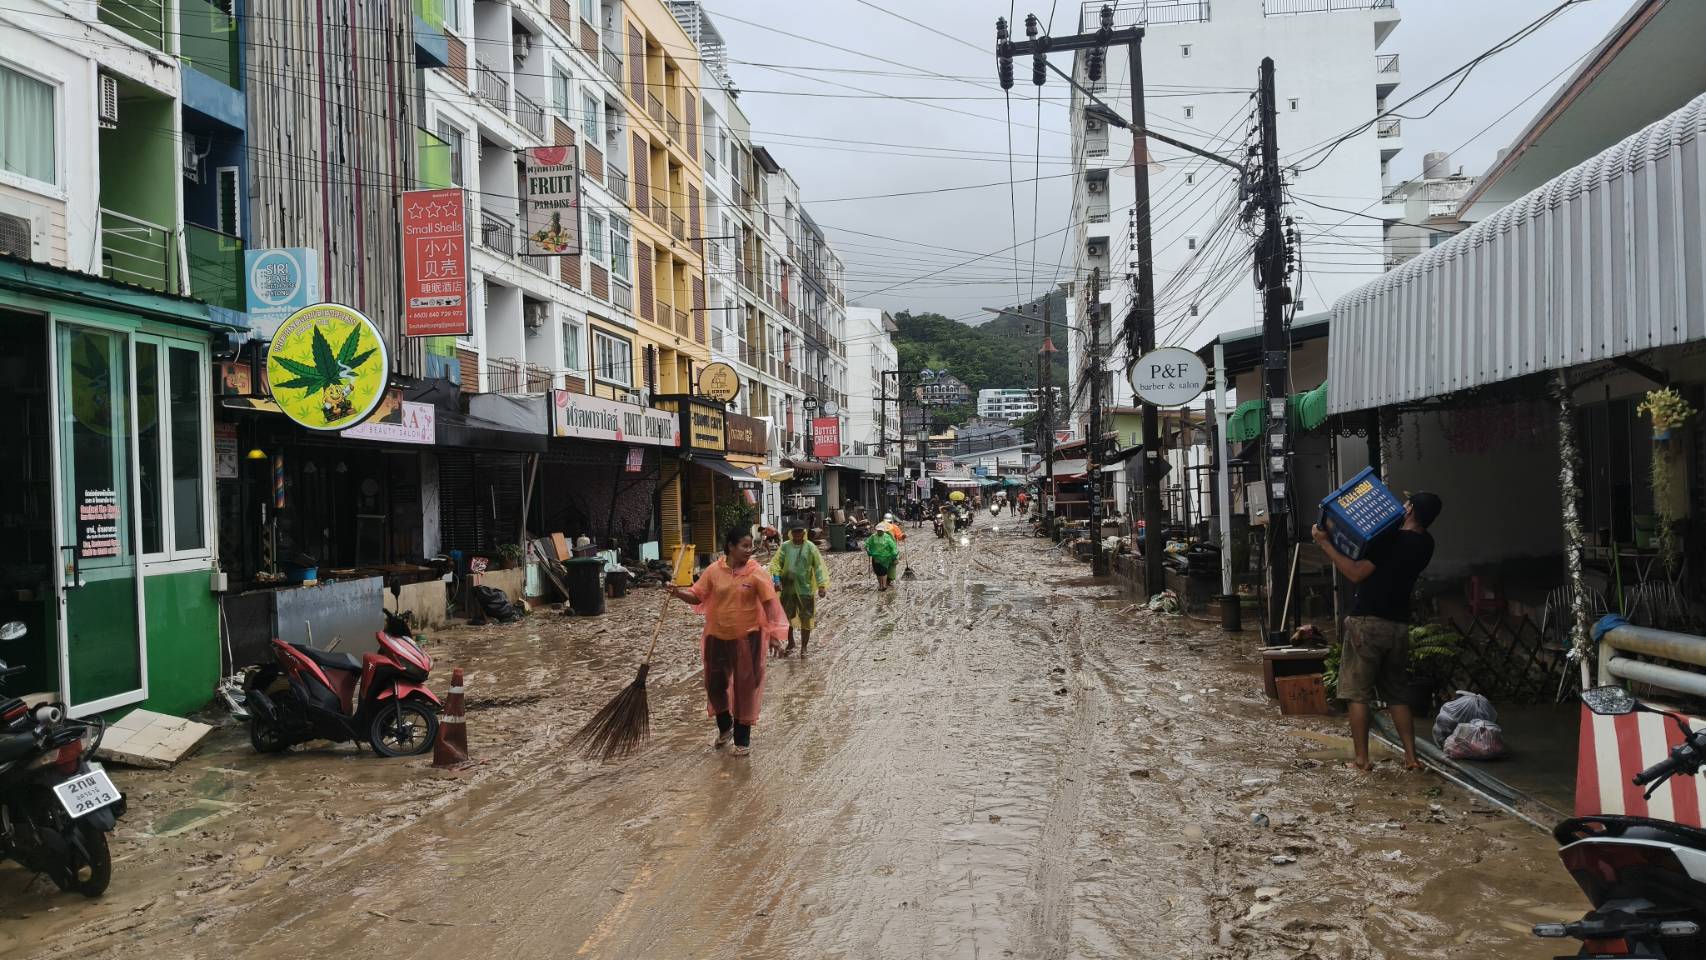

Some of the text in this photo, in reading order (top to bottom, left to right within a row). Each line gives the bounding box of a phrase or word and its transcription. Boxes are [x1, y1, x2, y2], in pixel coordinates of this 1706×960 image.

[530, 175, 573, 195] FRUIT
[534, 199, 570, 210] PARADISE
[406, 221, 462, 235] Small Shells
[425, 239, 458, 257] 小小
[266, 263, 288, 275] SIRI
[424, 259, 458, 278] 贝壳
[421, 282, 462, 293] 睡眠酒店
[1150, 363, 1189, 379] P&F
[1140, 382, 1165, 391] barber
[1179, 381, 1200, 389] salon
[369, 426, 396, 434] BEAUTY
[624, 412, 673, 439] FRUIT PARADISE
[814, 426, 838, 435] BUTTER
[814, 434, 838, 444] CHICKEN
[76, 793, 111, 812] 2813
